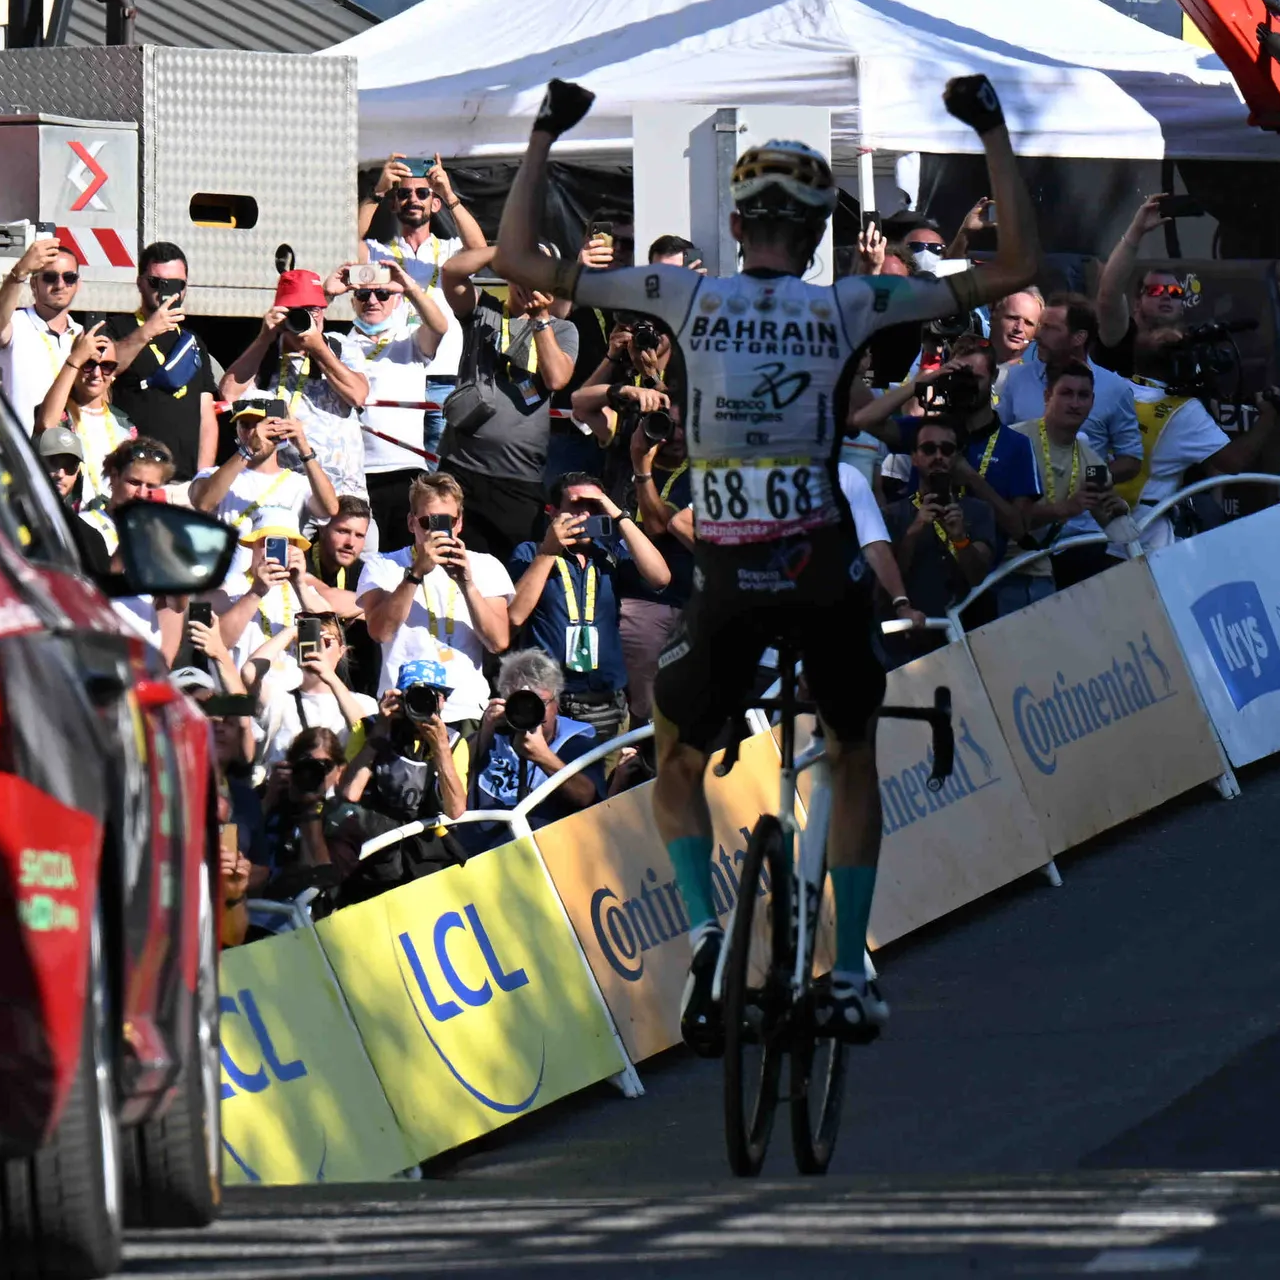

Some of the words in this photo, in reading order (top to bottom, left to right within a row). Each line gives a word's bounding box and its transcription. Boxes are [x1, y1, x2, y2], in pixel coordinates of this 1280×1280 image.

[689, 338, 840, 359] VICTORIOUS
[691, 316, 838, 344] BAHRAIN
[714, 411, 784, 426] energies
[716, 397, 766, 410] Bapco
[703, 470, 749, 521] 68
[766, 467, 813, 520] 68
[1209, 602, 1269, 679] Krys
[1011, 658, 1153, 777] Continental
[398, 902, 530, 1022] LCL
